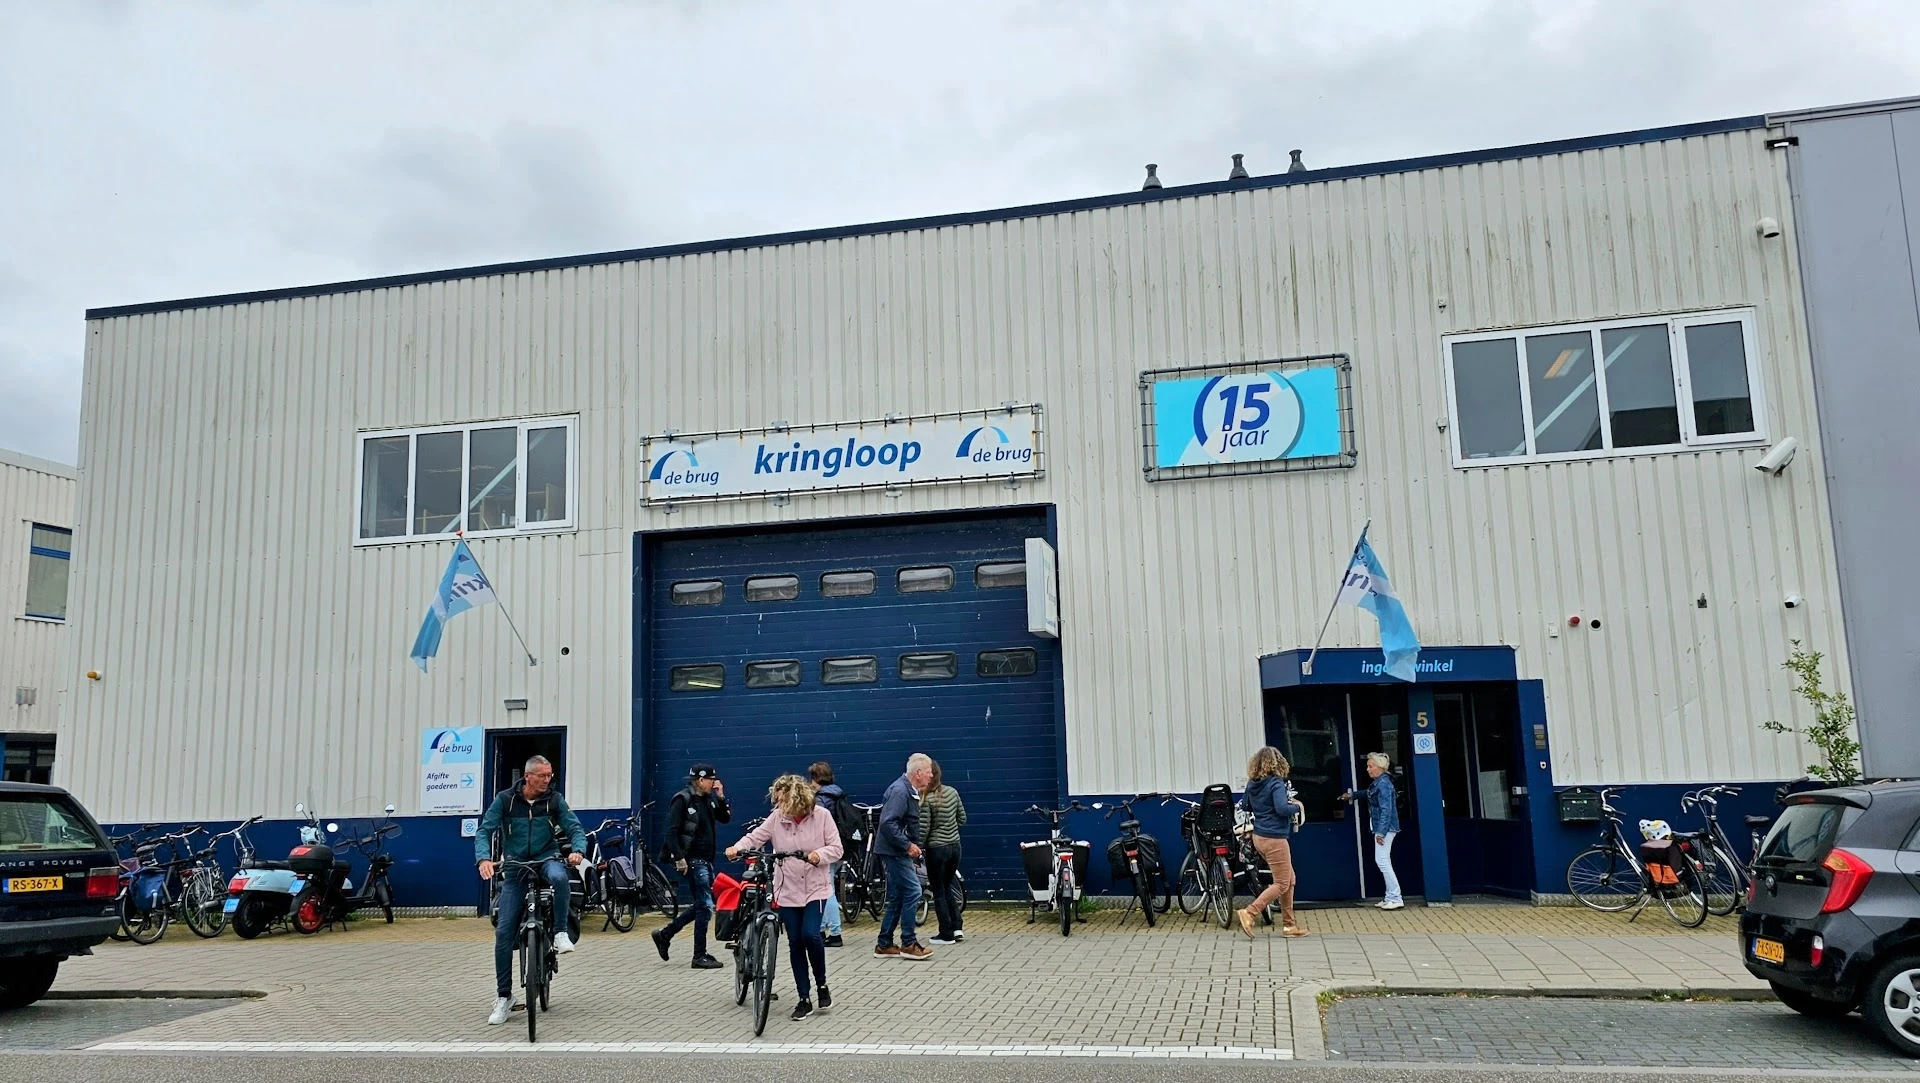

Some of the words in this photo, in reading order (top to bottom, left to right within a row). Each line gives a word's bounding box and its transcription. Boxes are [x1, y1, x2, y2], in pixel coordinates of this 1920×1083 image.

[1219, 383, 1271, 432] 15
[1220, 425, 1269, 453] jaar
[754, 438, 921, 477] kringloop
[972, 448, 990, 463] de
[995, 447, 1031, 463] brug
[664, 471, 682, 485] de
[685, 470, 719, 486] brug
[1416, 711, 1428, 728] 5
[439, 743, 450, 752] de
[451, 743, 473, 754] brug
[426, 772, 449, 781] Afgifte
[426, 783, 458, 791] goederen
[12, 878, 59, 890] RS-367-X
